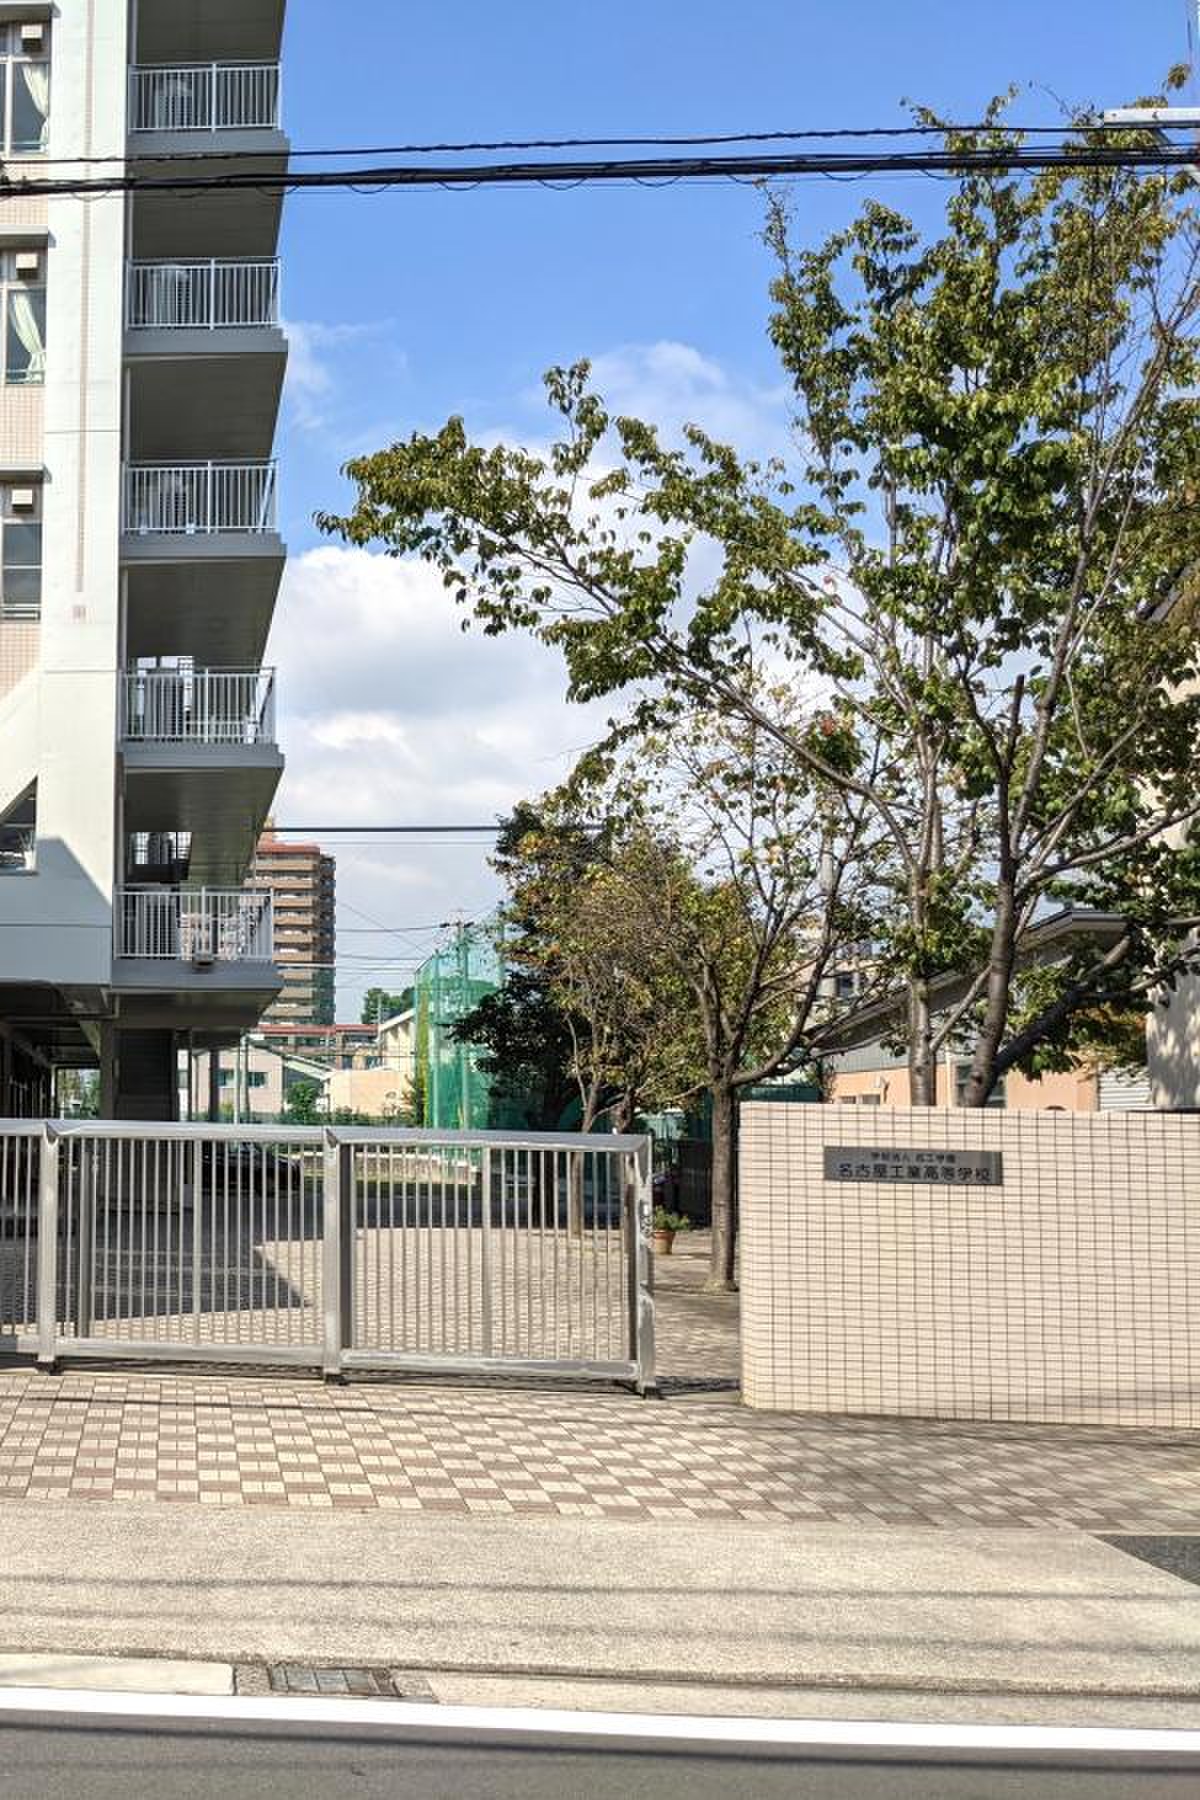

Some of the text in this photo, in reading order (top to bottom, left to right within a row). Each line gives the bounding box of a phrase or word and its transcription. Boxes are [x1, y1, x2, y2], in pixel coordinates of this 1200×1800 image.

[839, 1163, 991, 1181] 名古屋工業高等学校
